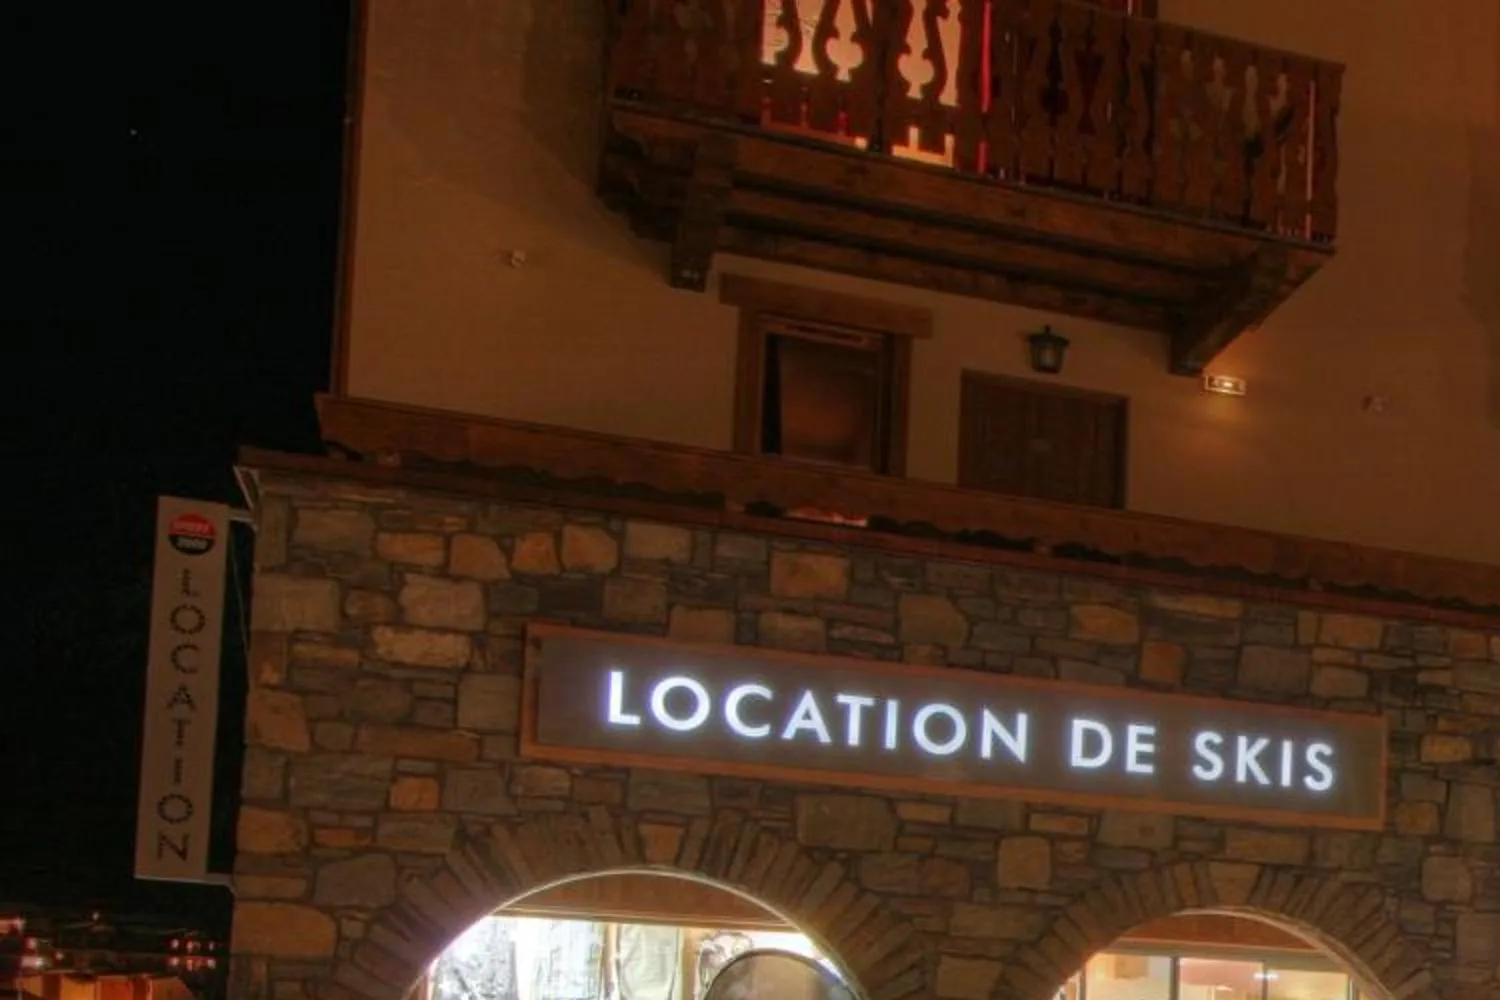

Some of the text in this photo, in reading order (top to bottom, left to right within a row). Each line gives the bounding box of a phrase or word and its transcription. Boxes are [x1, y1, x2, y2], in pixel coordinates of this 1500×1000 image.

[156, 567, 207, 862] LOCATION
[605, 668, 1335, 792] LOCATION DE SKIS
